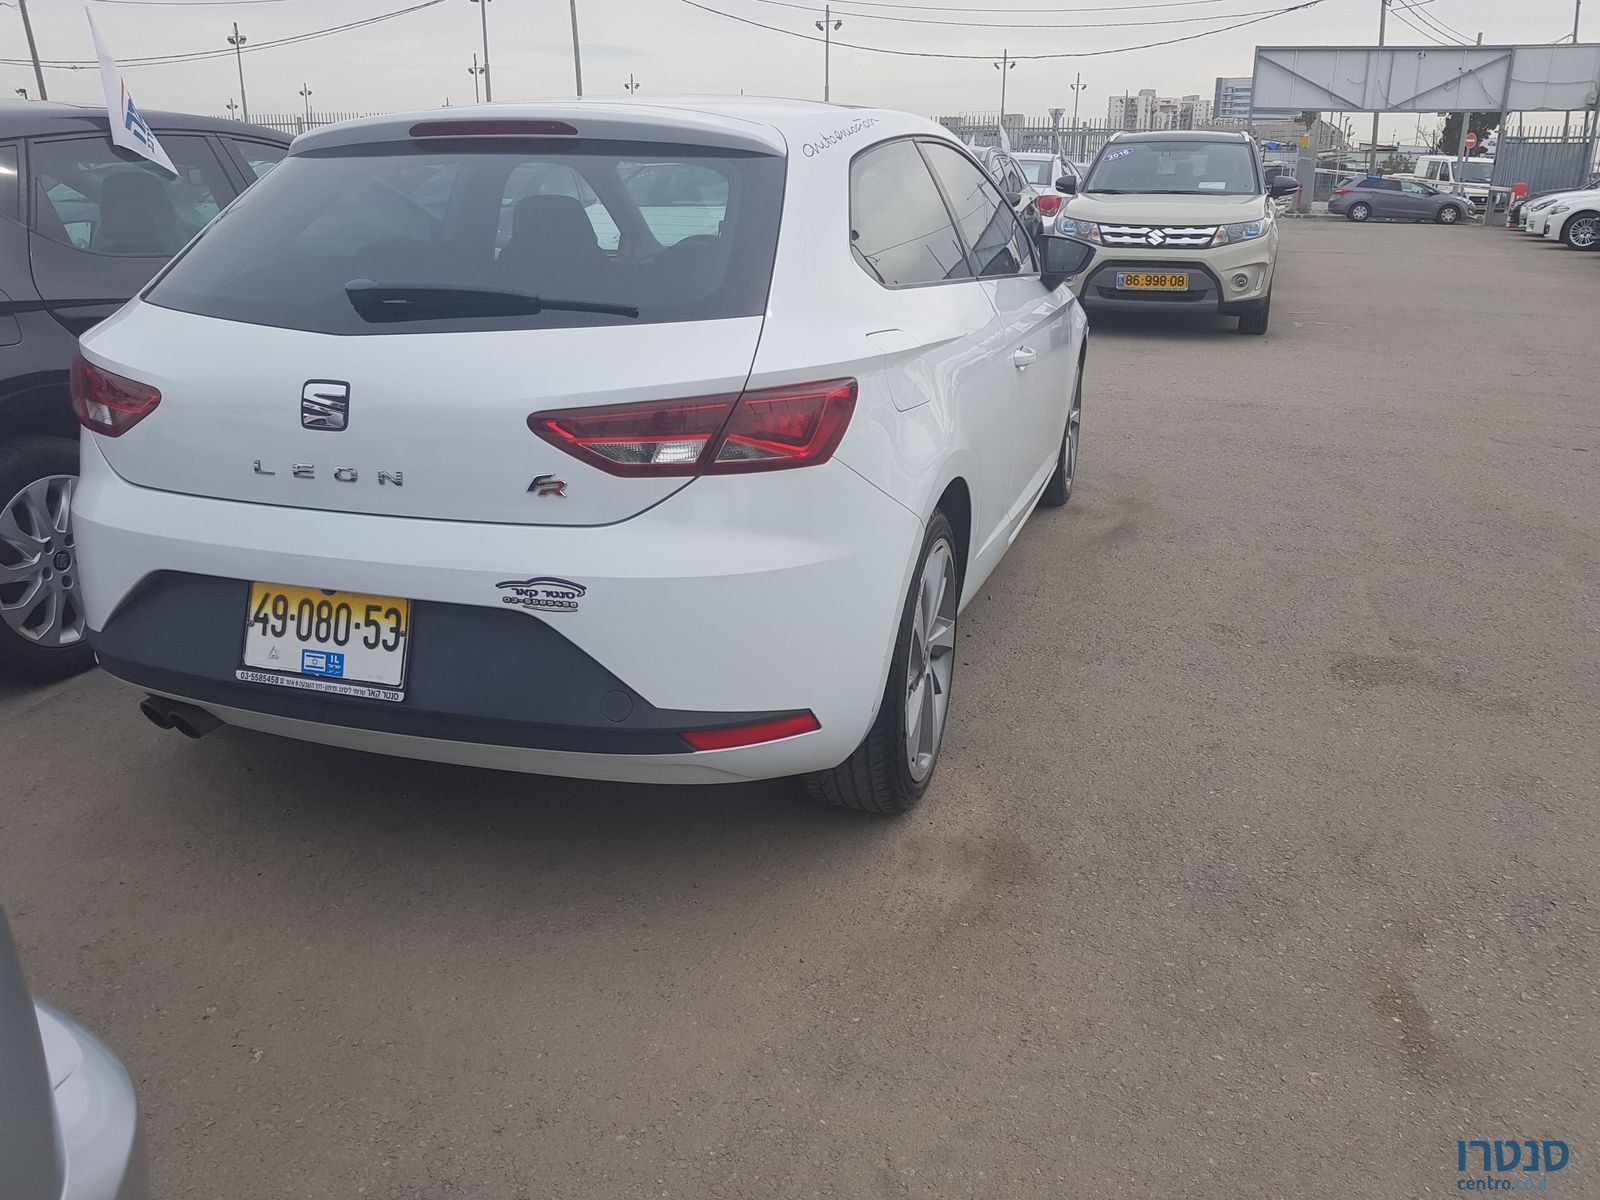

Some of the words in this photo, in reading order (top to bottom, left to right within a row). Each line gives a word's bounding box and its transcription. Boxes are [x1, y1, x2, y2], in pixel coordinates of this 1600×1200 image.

[253, 459, 403, 487] LEON
[526, 473, 567, 498] FR
[511, 588, 539, 598] קאר
[541, 590, 576, 600] סנטר
[330, 655, 340, 664] IL
[240, 671, 280, 684] 03-5585458
[368, 689, 381, 699] קאר
[382, 691, 399, 701] סנטר
